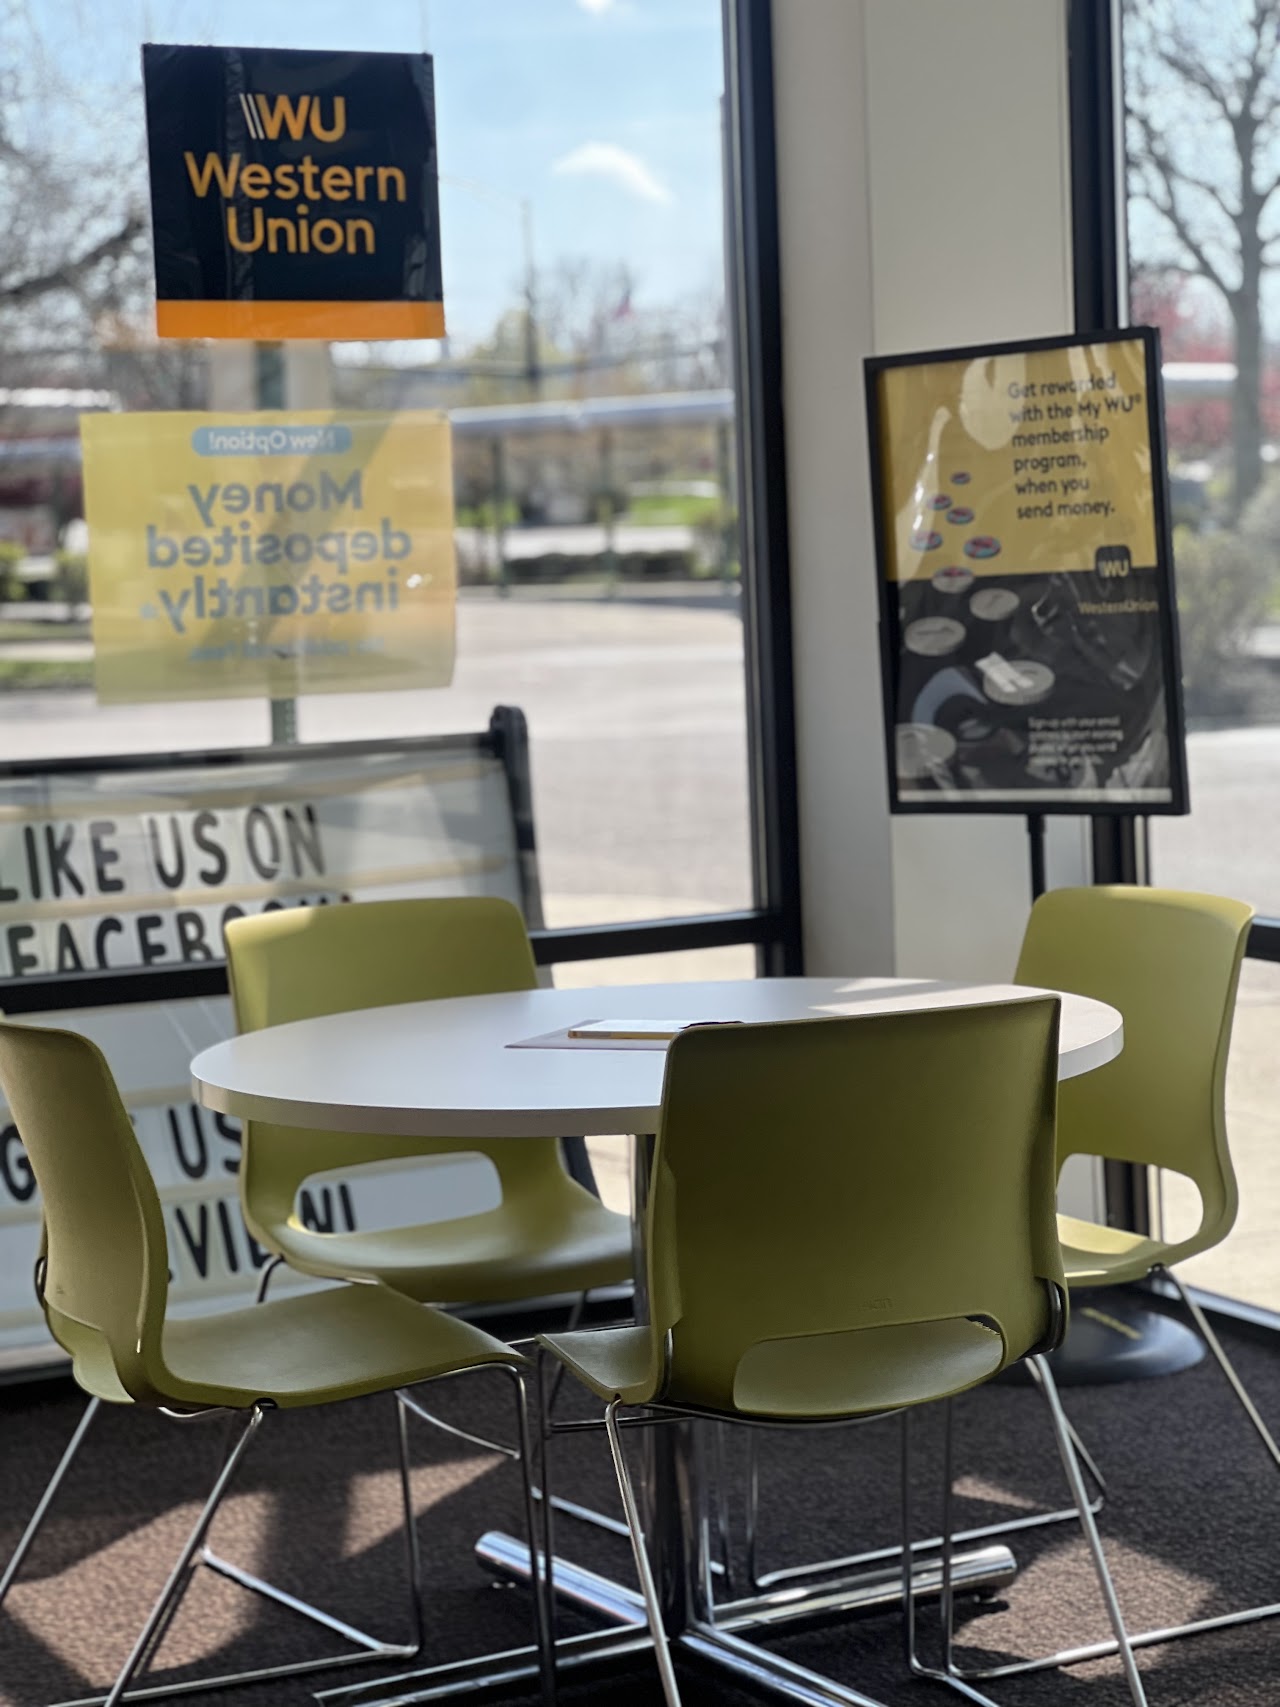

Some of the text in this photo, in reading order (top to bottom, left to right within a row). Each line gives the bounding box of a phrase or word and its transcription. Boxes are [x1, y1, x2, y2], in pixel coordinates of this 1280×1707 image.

[250, 93, 346, 142] WU
[184, 151, 406, 202] Western
[226, 204, 375, 254] Union
[1008, 371, 1117, 399] Get rewarded
[1009, 404, 1044, 422] with
[1047, 401, 1073, 420] the
[1078, 401, 1101, 419] My
[1011, 424, 1110, 448] membership
[1015, 478, 1090, 497] when you
[1017, 500, 1116, 519] send money.
[149, 812, 228, 889] US
[245, 806, 324, 881] ON
